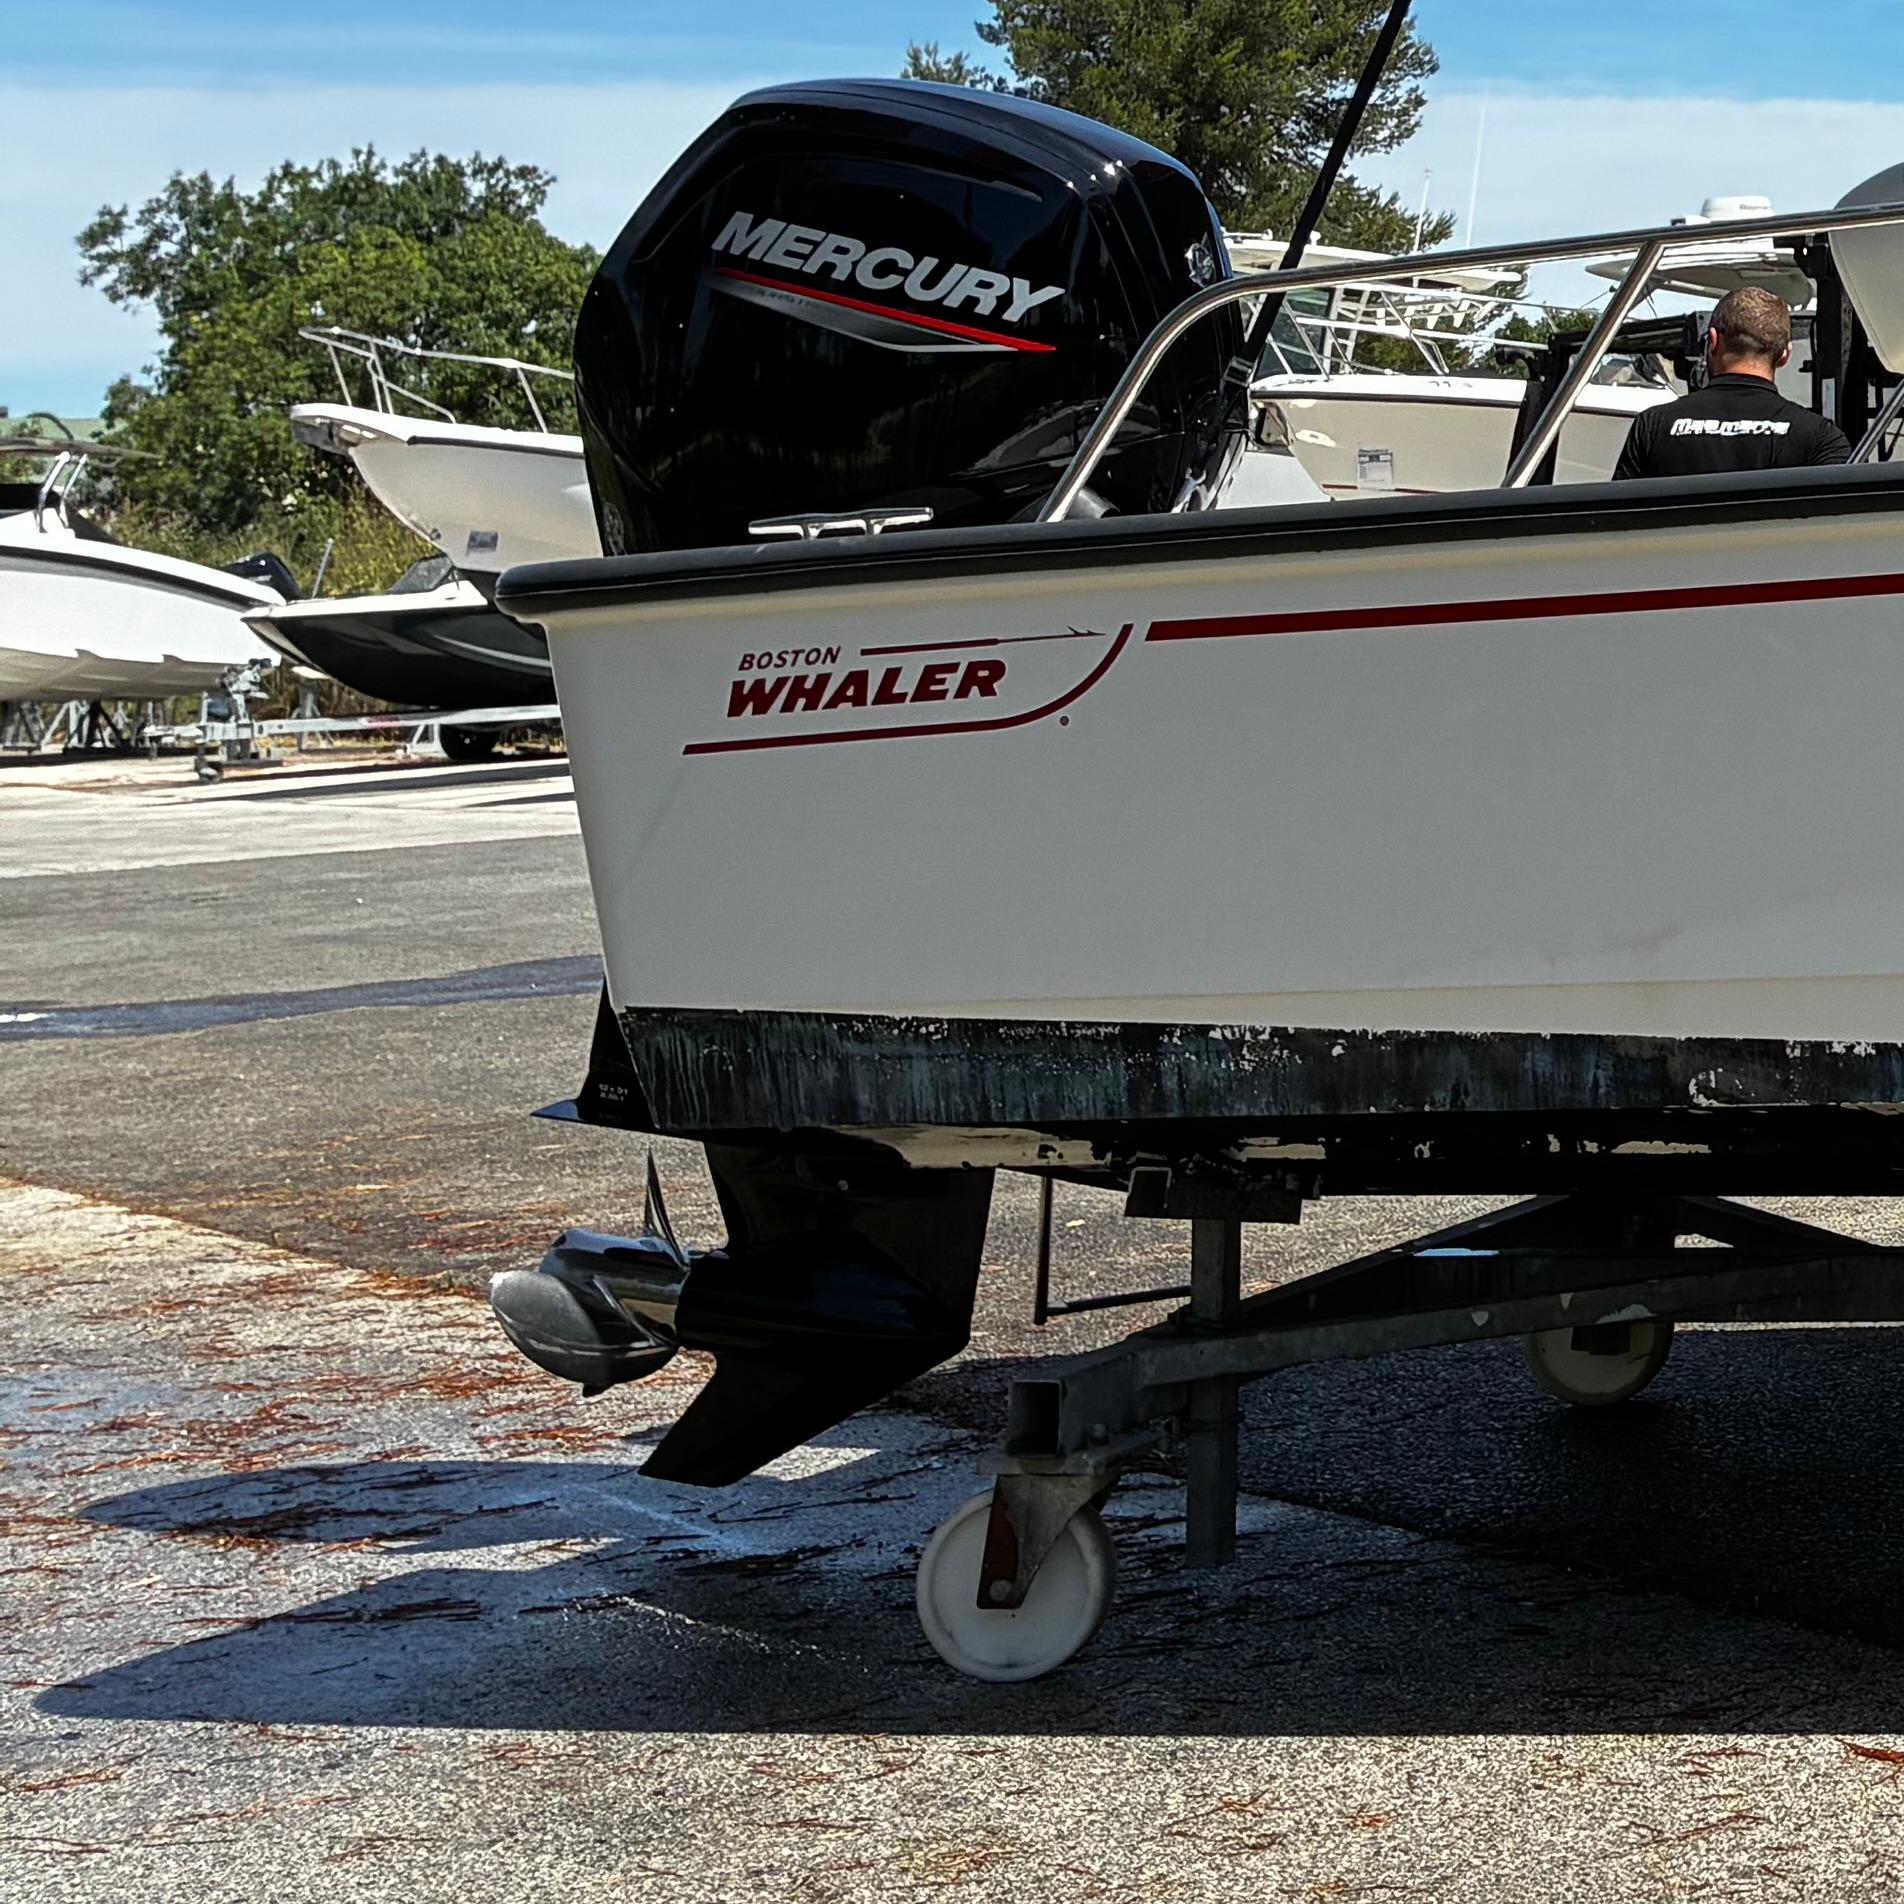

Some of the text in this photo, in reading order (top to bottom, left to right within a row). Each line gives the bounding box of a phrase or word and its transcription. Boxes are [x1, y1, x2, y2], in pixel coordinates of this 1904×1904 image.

[711, 211, 1065, 323] MERCURY
[727, 658, 1006, 718] WHALER
[738, 646, 841, 672] BOSTON
